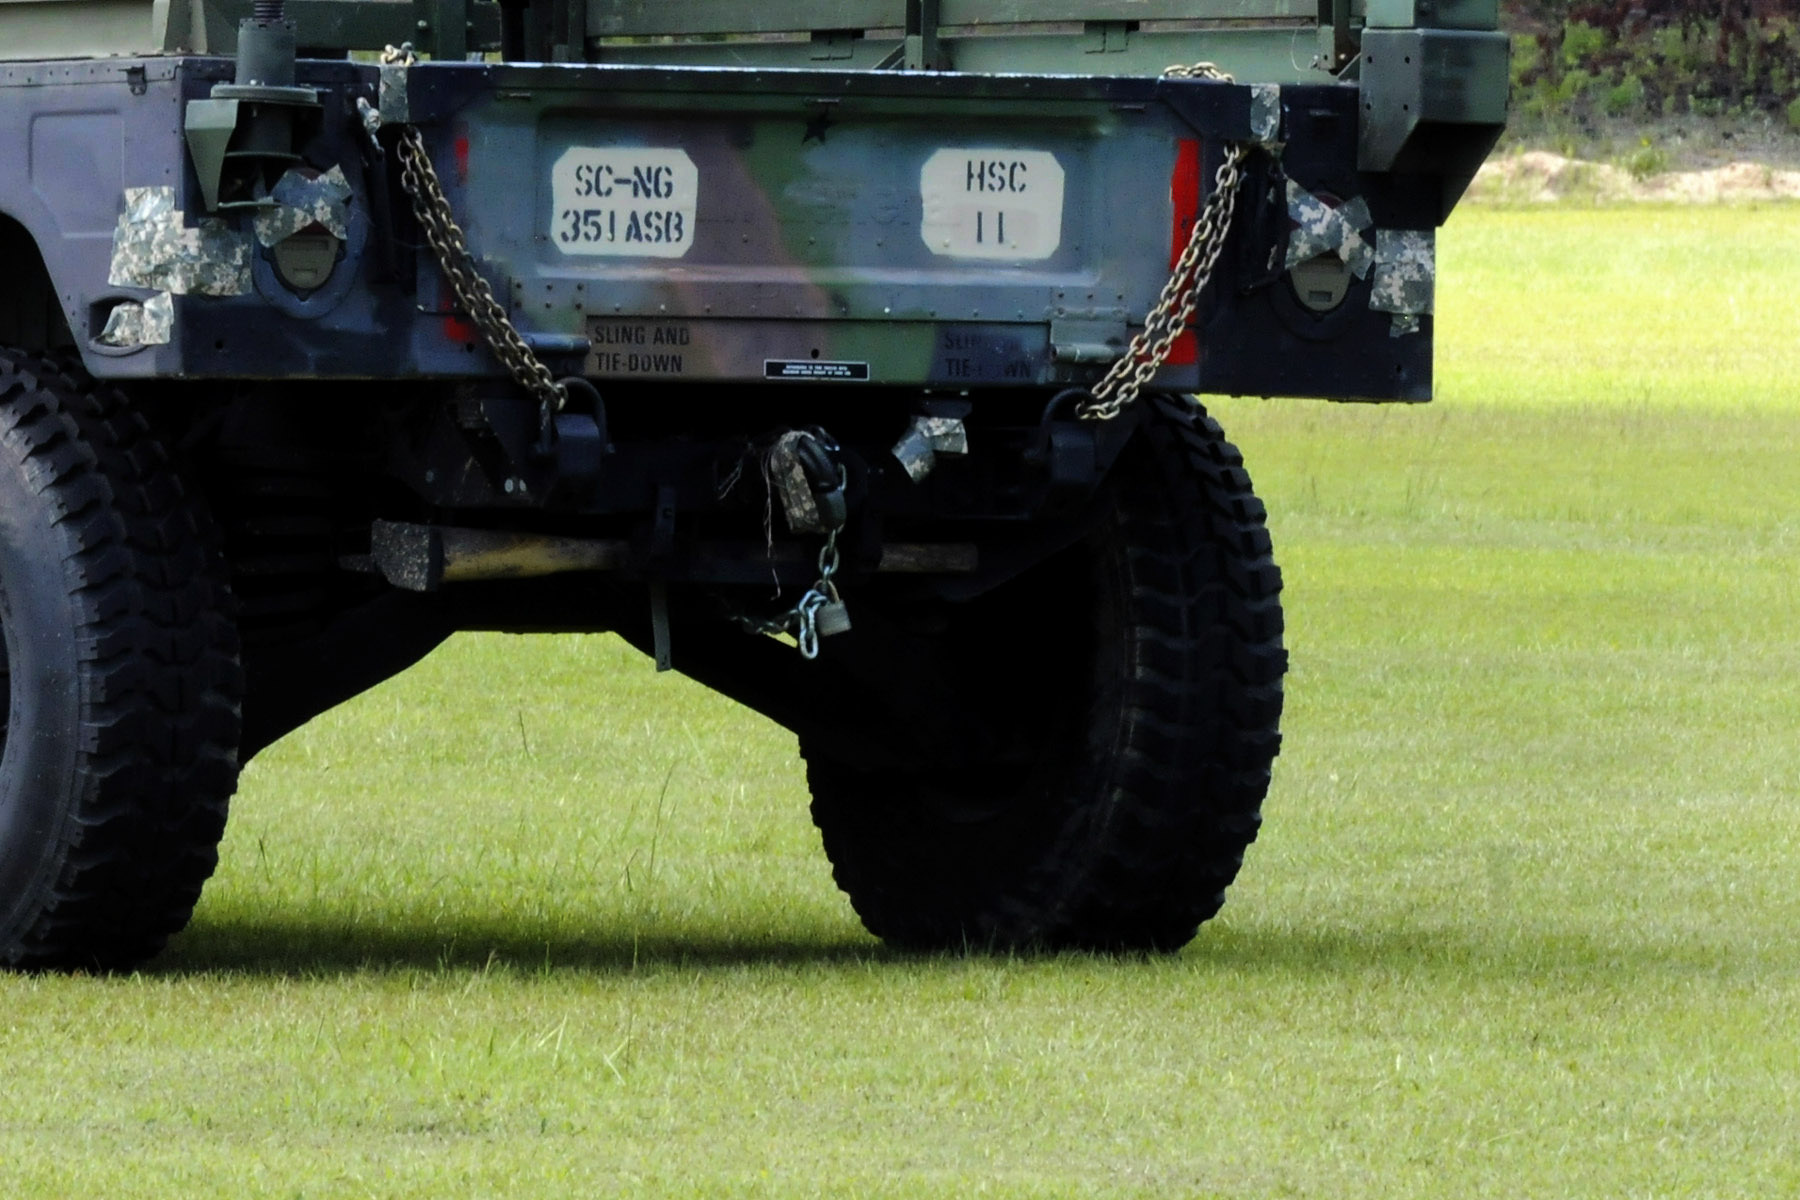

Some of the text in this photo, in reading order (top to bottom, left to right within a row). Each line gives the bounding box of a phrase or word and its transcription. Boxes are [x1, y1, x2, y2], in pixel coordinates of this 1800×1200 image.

[575, 165, 673, 199] SC-NG
[966, 160, 1027, 192] HSC
[595, 325, 690, 346] SLING AND
[595, 352, 682, 373] TIE-DOWN
